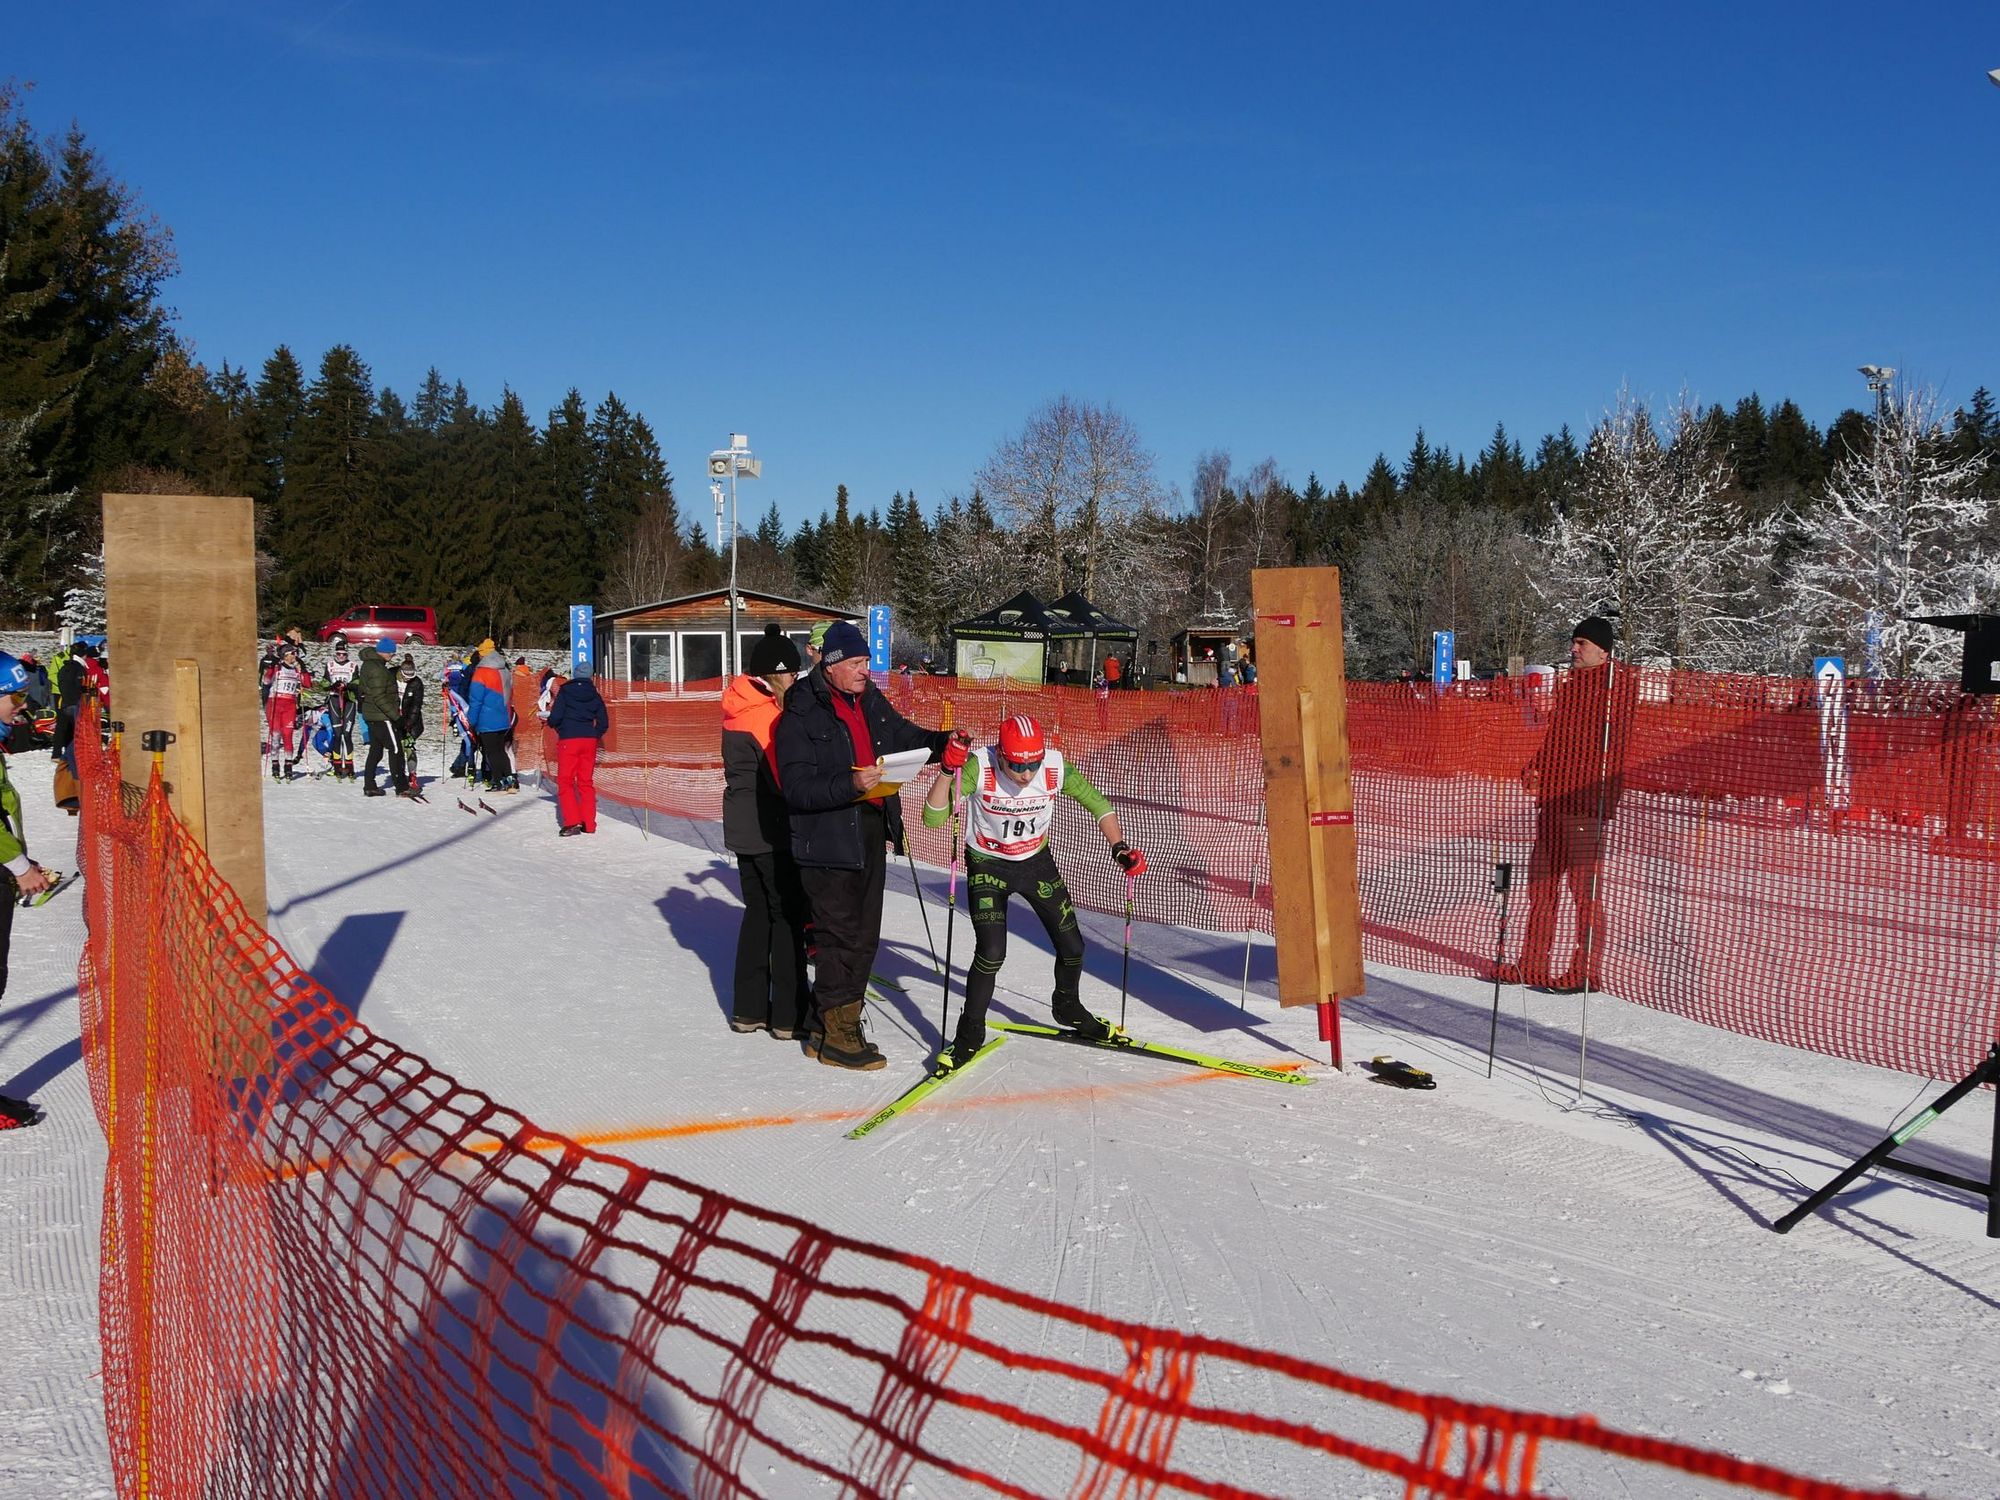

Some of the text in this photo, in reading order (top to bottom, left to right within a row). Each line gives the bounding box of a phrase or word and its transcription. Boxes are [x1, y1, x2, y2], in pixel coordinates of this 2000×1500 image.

[577, 609, 588, 662] STAR
[876, 609, 884, 664] ZIEL
[992, 798, 1046, 806] SPORT
[1002, 817, 1036, 839] 191
[1219, 1061, 1287, 1080] FISCHER
[863, 1108, 896, 1132] FISCHER
